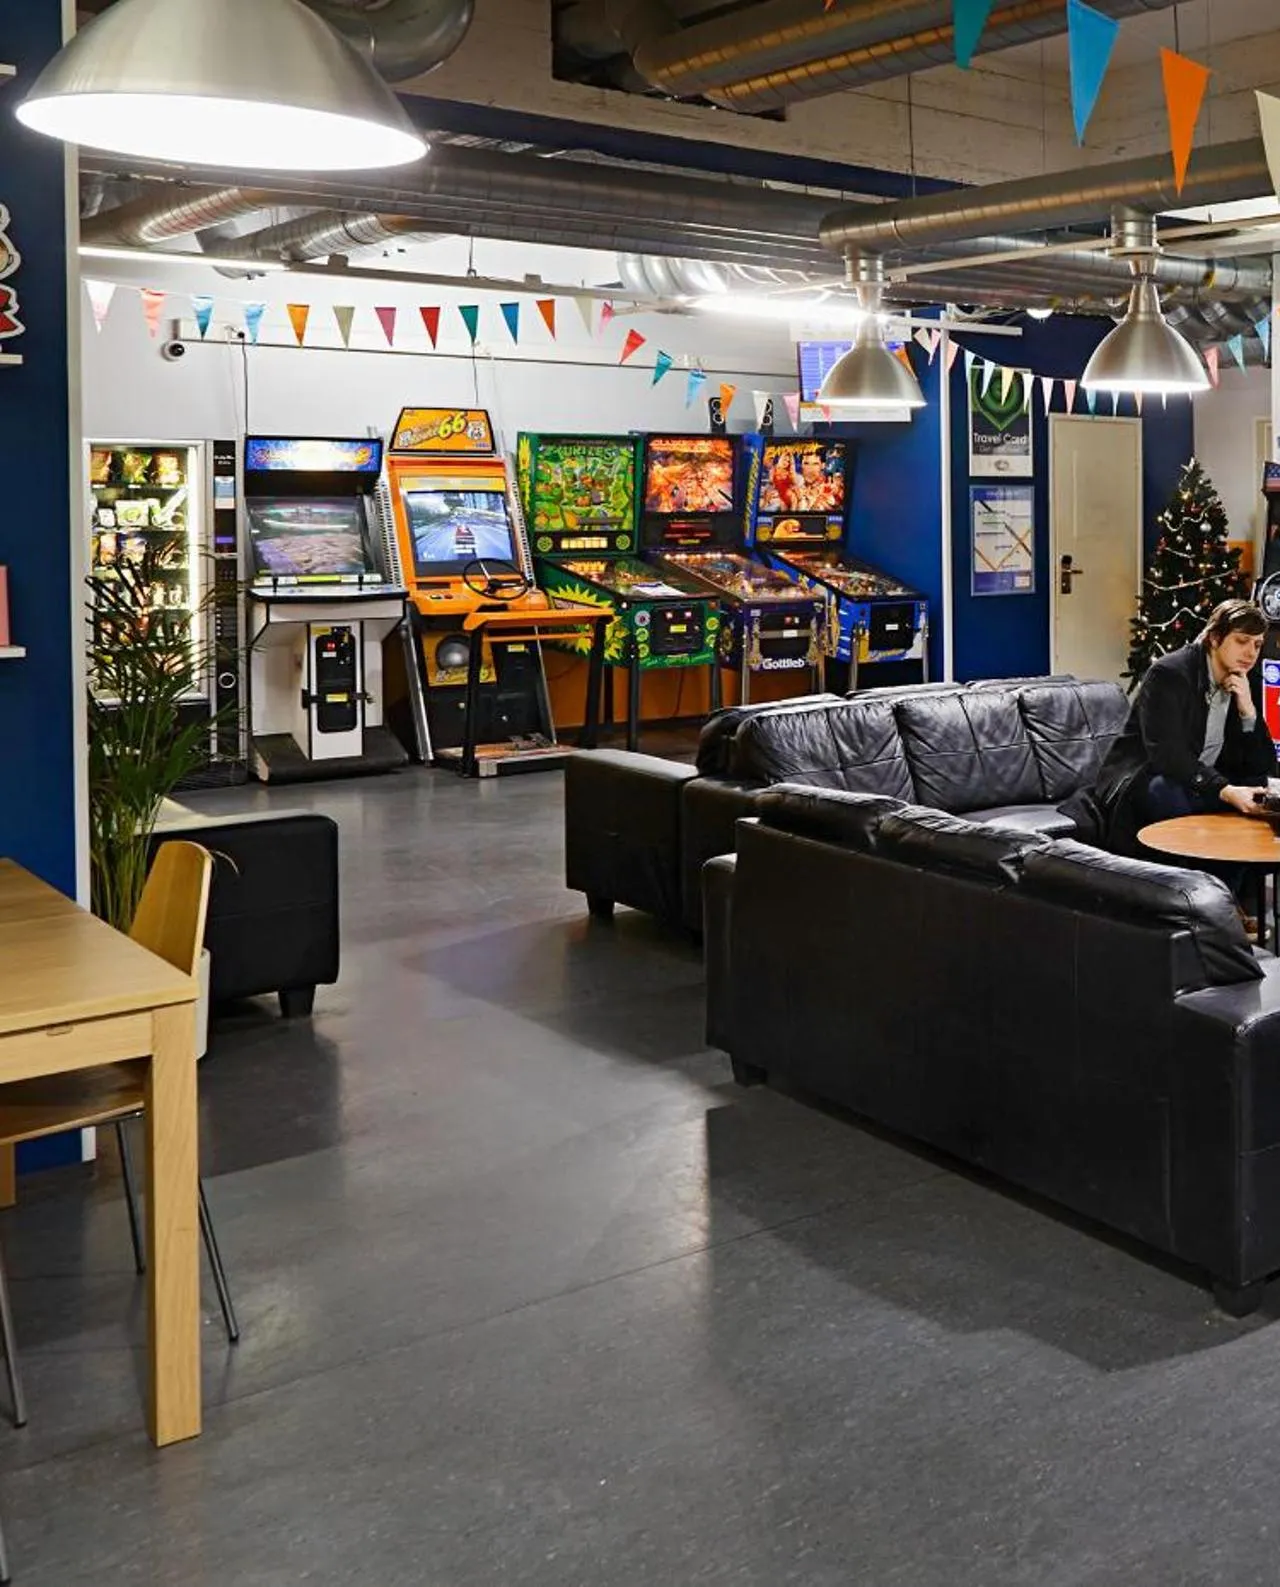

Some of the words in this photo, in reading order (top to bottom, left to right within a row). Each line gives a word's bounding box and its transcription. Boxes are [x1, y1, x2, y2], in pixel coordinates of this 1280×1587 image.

[438, 410, 468, 439] 66
[974, 431, 1002, 443] Travel
[1003, 433, 1027, 445] Card
[763, 658, 805, 670] Gottlieb
